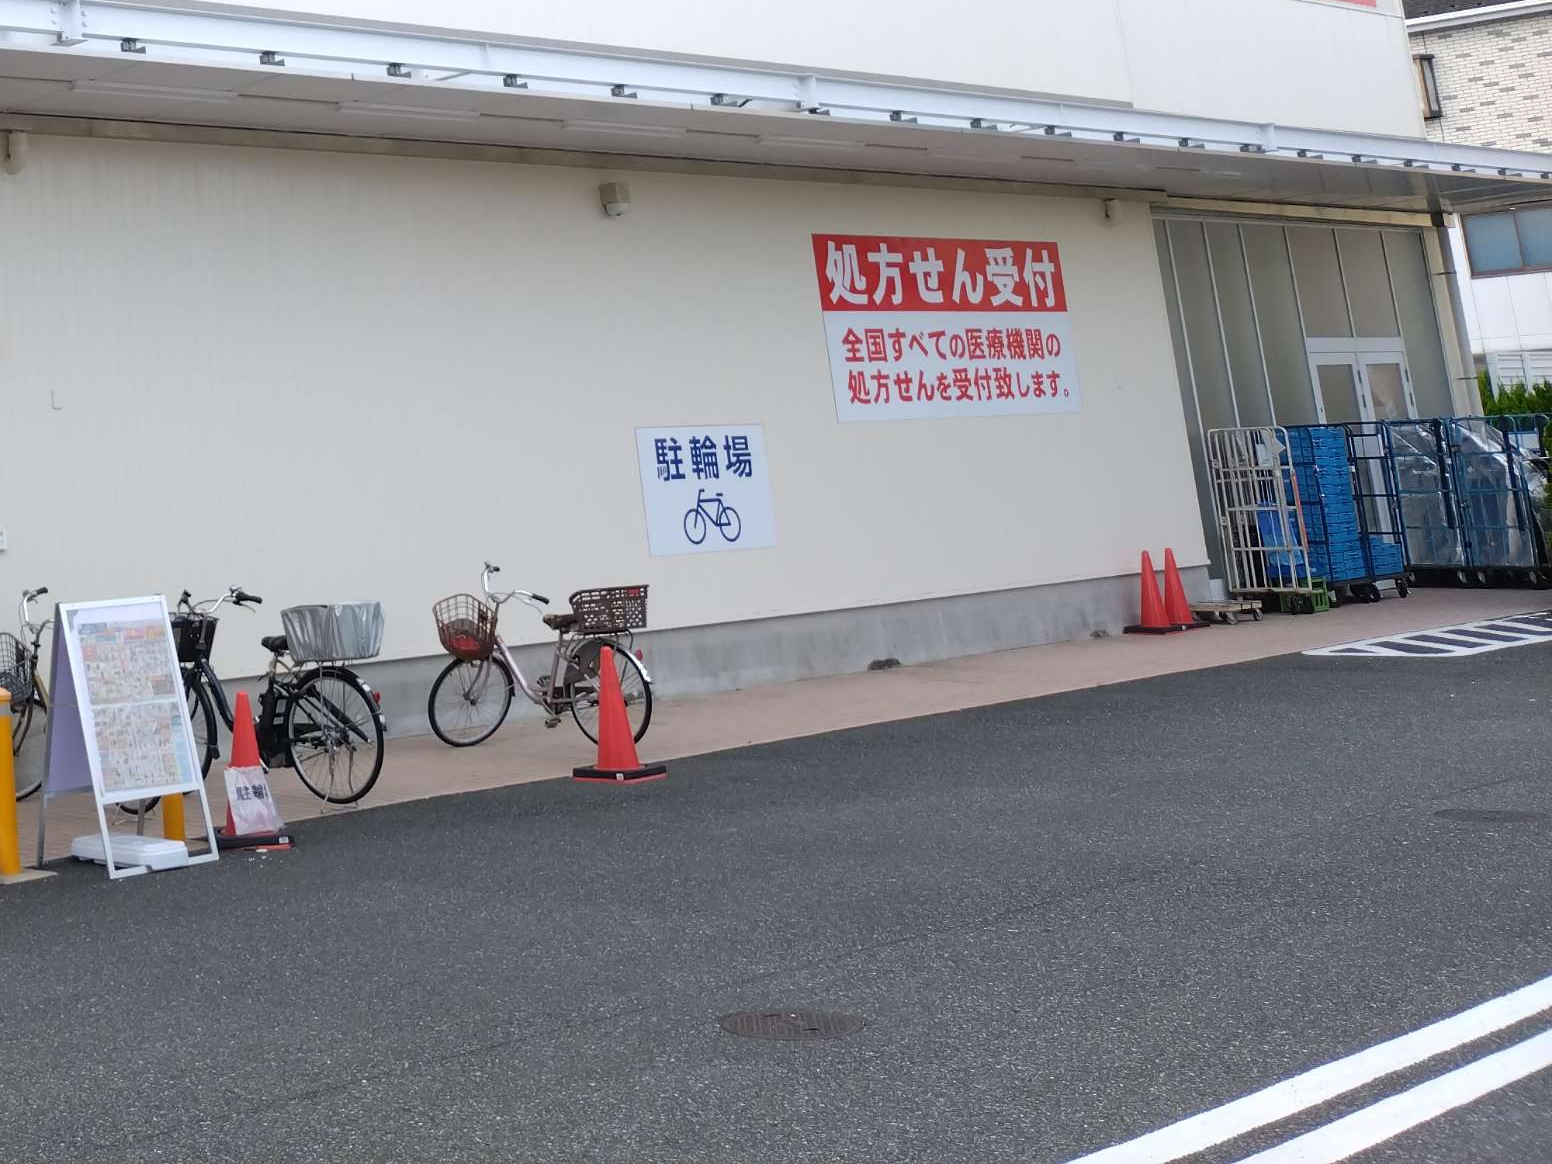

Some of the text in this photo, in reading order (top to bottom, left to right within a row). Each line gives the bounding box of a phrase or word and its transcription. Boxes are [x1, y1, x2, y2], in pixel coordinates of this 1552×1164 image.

[825, 240, 1056, 308] 処方せん受付
[842, 328, 1061, 363] 全国すべての医療機関の
[847, 367, 1070, 405] 処方せんを受付致します。
[654, 435, 753, 482] 駐輪場
